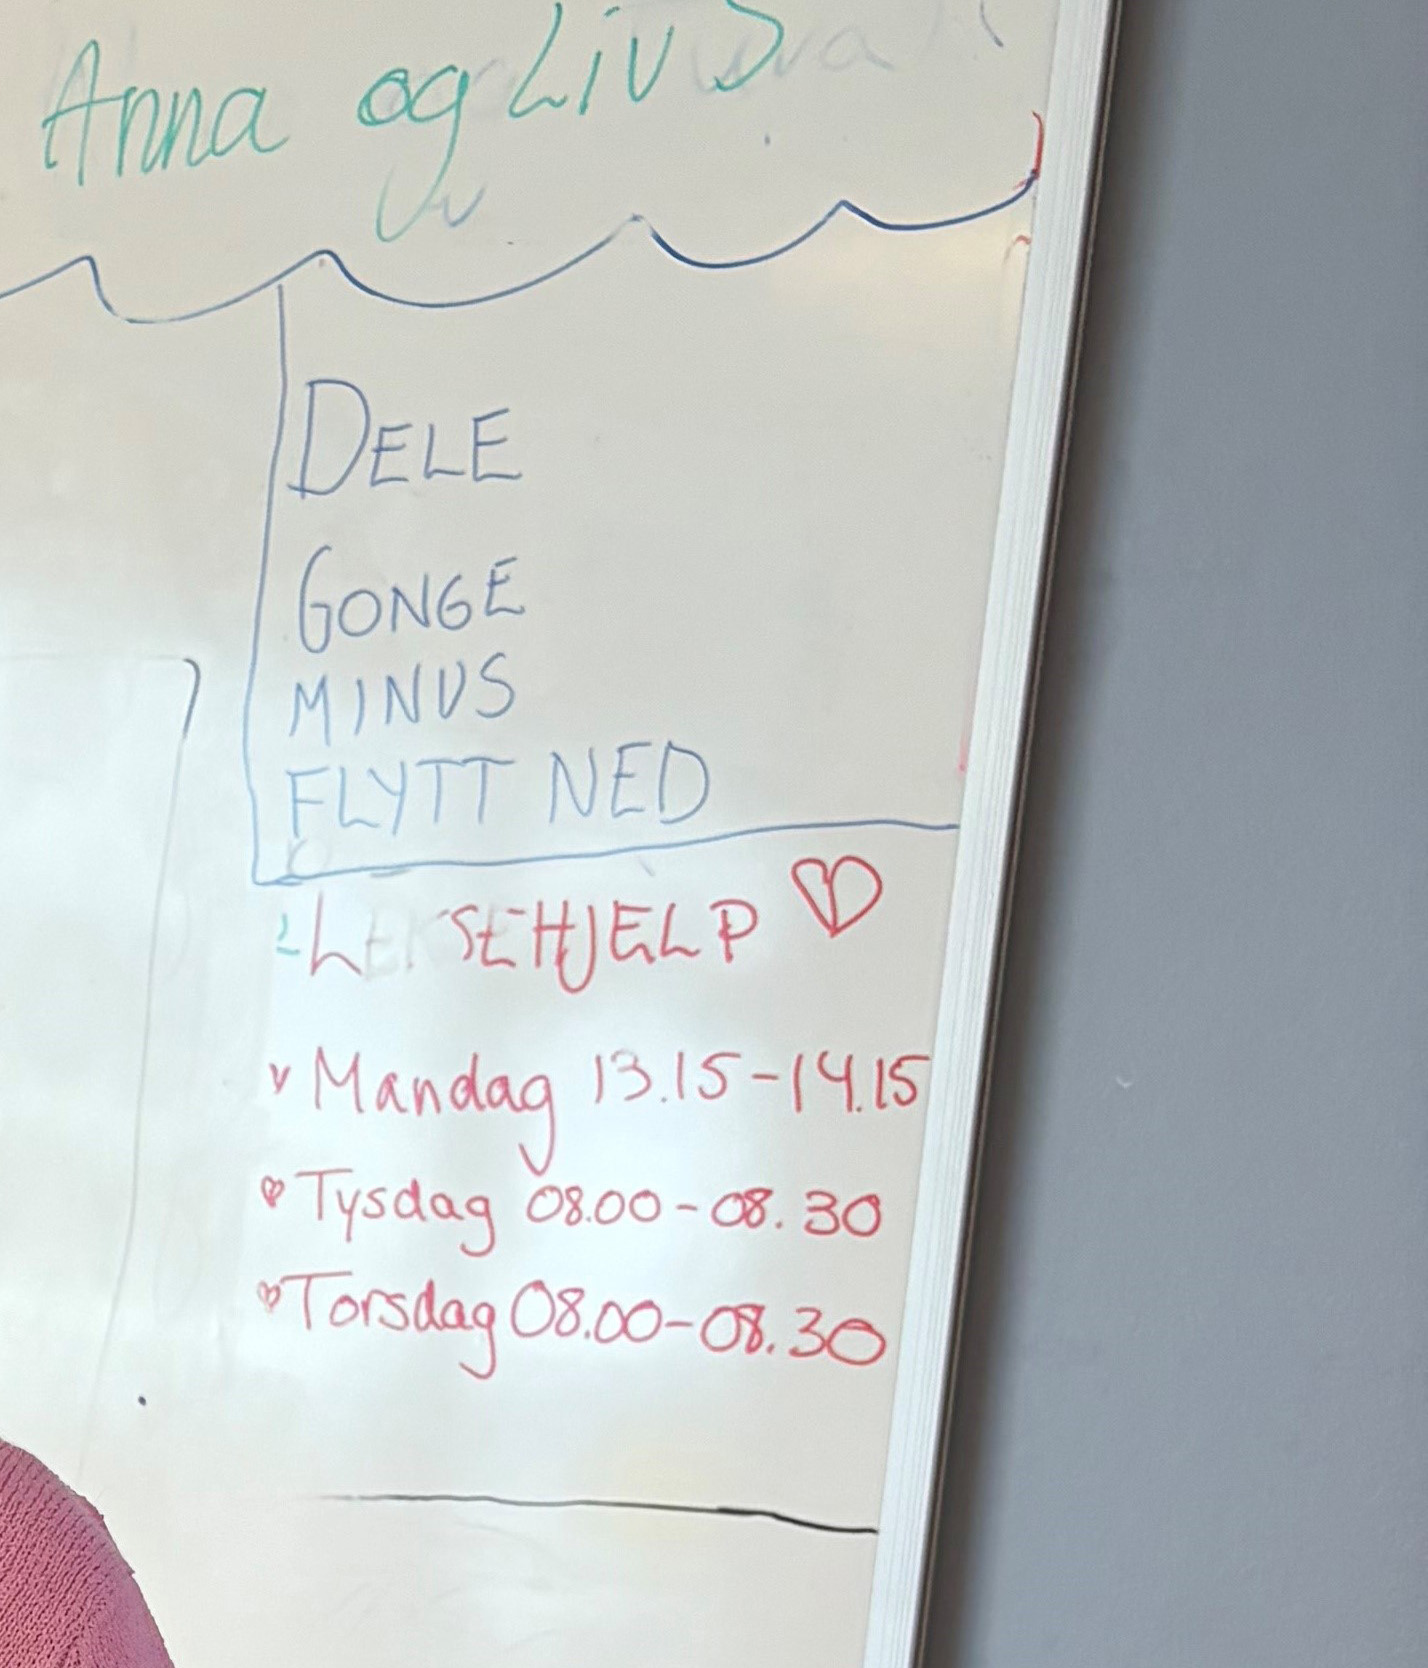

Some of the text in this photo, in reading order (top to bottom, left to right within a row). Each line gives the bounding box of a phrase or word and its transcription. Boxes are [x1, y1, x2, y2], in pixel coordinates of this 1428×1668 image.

[42, 39, 290, 186] Anna
[356, 62, 471, 243] og
[287, 379, 523, 499] DELE
[298, 545, 525, 653] GONGE
[289, 652, 516, 746] MINUS
[285, 741, 710, 840] FLYTT NED
[312, 1045, 555, 1177] Mandag
[294, 1167, 497, 1257] Tysdag
[279, 1270, 498, 1380] Torsdag
